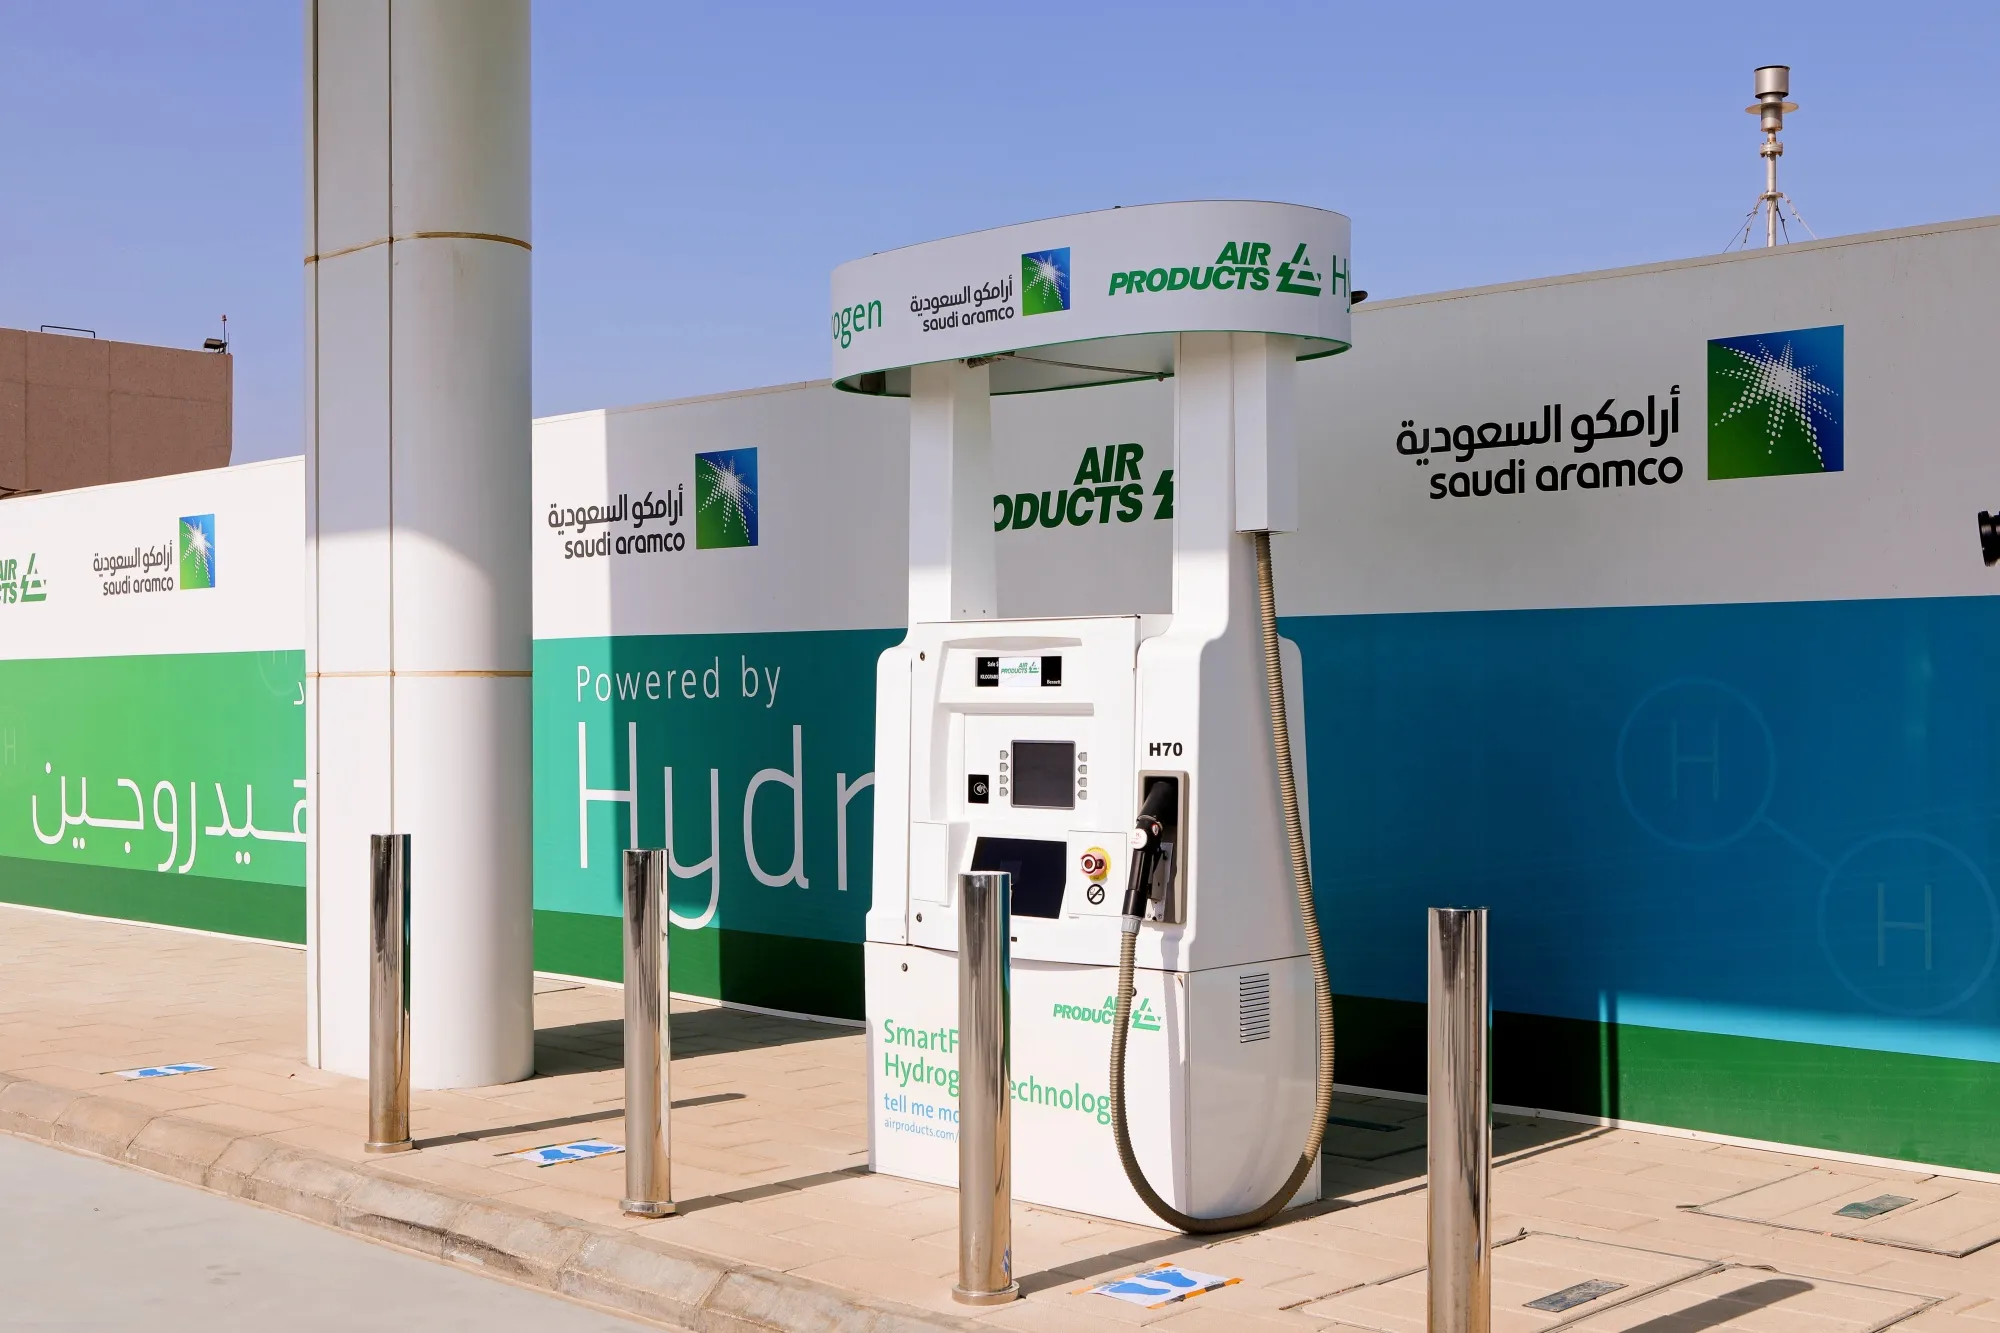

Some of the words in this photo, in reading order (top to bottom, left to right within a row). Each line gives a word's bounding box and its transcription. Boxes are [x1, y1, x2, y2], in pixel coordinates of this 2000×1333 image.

[1215, 241, 1272, 266] AIR
[973, 275, 1013, 307] أرامكو
[1108, 266, 1271, 296] PRODUCTS
[910, 286, 971, 317] السعودية
[832, 299, 882, 349] ogen
[923, 311, 959, 332] saudi
[962, 306, 1015, 326] aramco
[1396, 404, 1562, 466] السعودية
[1570, 385, 1681, 453] أرامكو
[1073, 443, 1144, 485] AIR
[1429, 459, 1526, 500] saudi
[1535, 456, 1684, 491] aramco
[548, 493, 628, 535] السعودية
[632, 483, 684, 528] أرامكو
[993, 483, 1144, 532] ODUCTS
[143, 540, 173, 573] أرامكو
[565, 531, 611, 559] saudi
[615, 532, 685, 554] aramco
[93, 547, 141, 577] السعودية
[103, 575, 131, 596] saudi
[133, 577, 174, 594] aramco
[576, 656, 721, 703] Powered
[741, 655, 781, 708] by
[1149, 742, 1183, 757] H70
[578, 721, 875, 930] Hydr
[1103, 995, 1119, 1010] AI
[884, 1018, 959, 1053] SmartF
[885, 1052, 959, 1097] Hydrog
[1010, 1075, 1112, 1125] echnolog
[884, 1093, 907, 1113] tell
[912, 1102, 934, 1118] me
[884, 1117, 959, 1143] airproducts.com/
